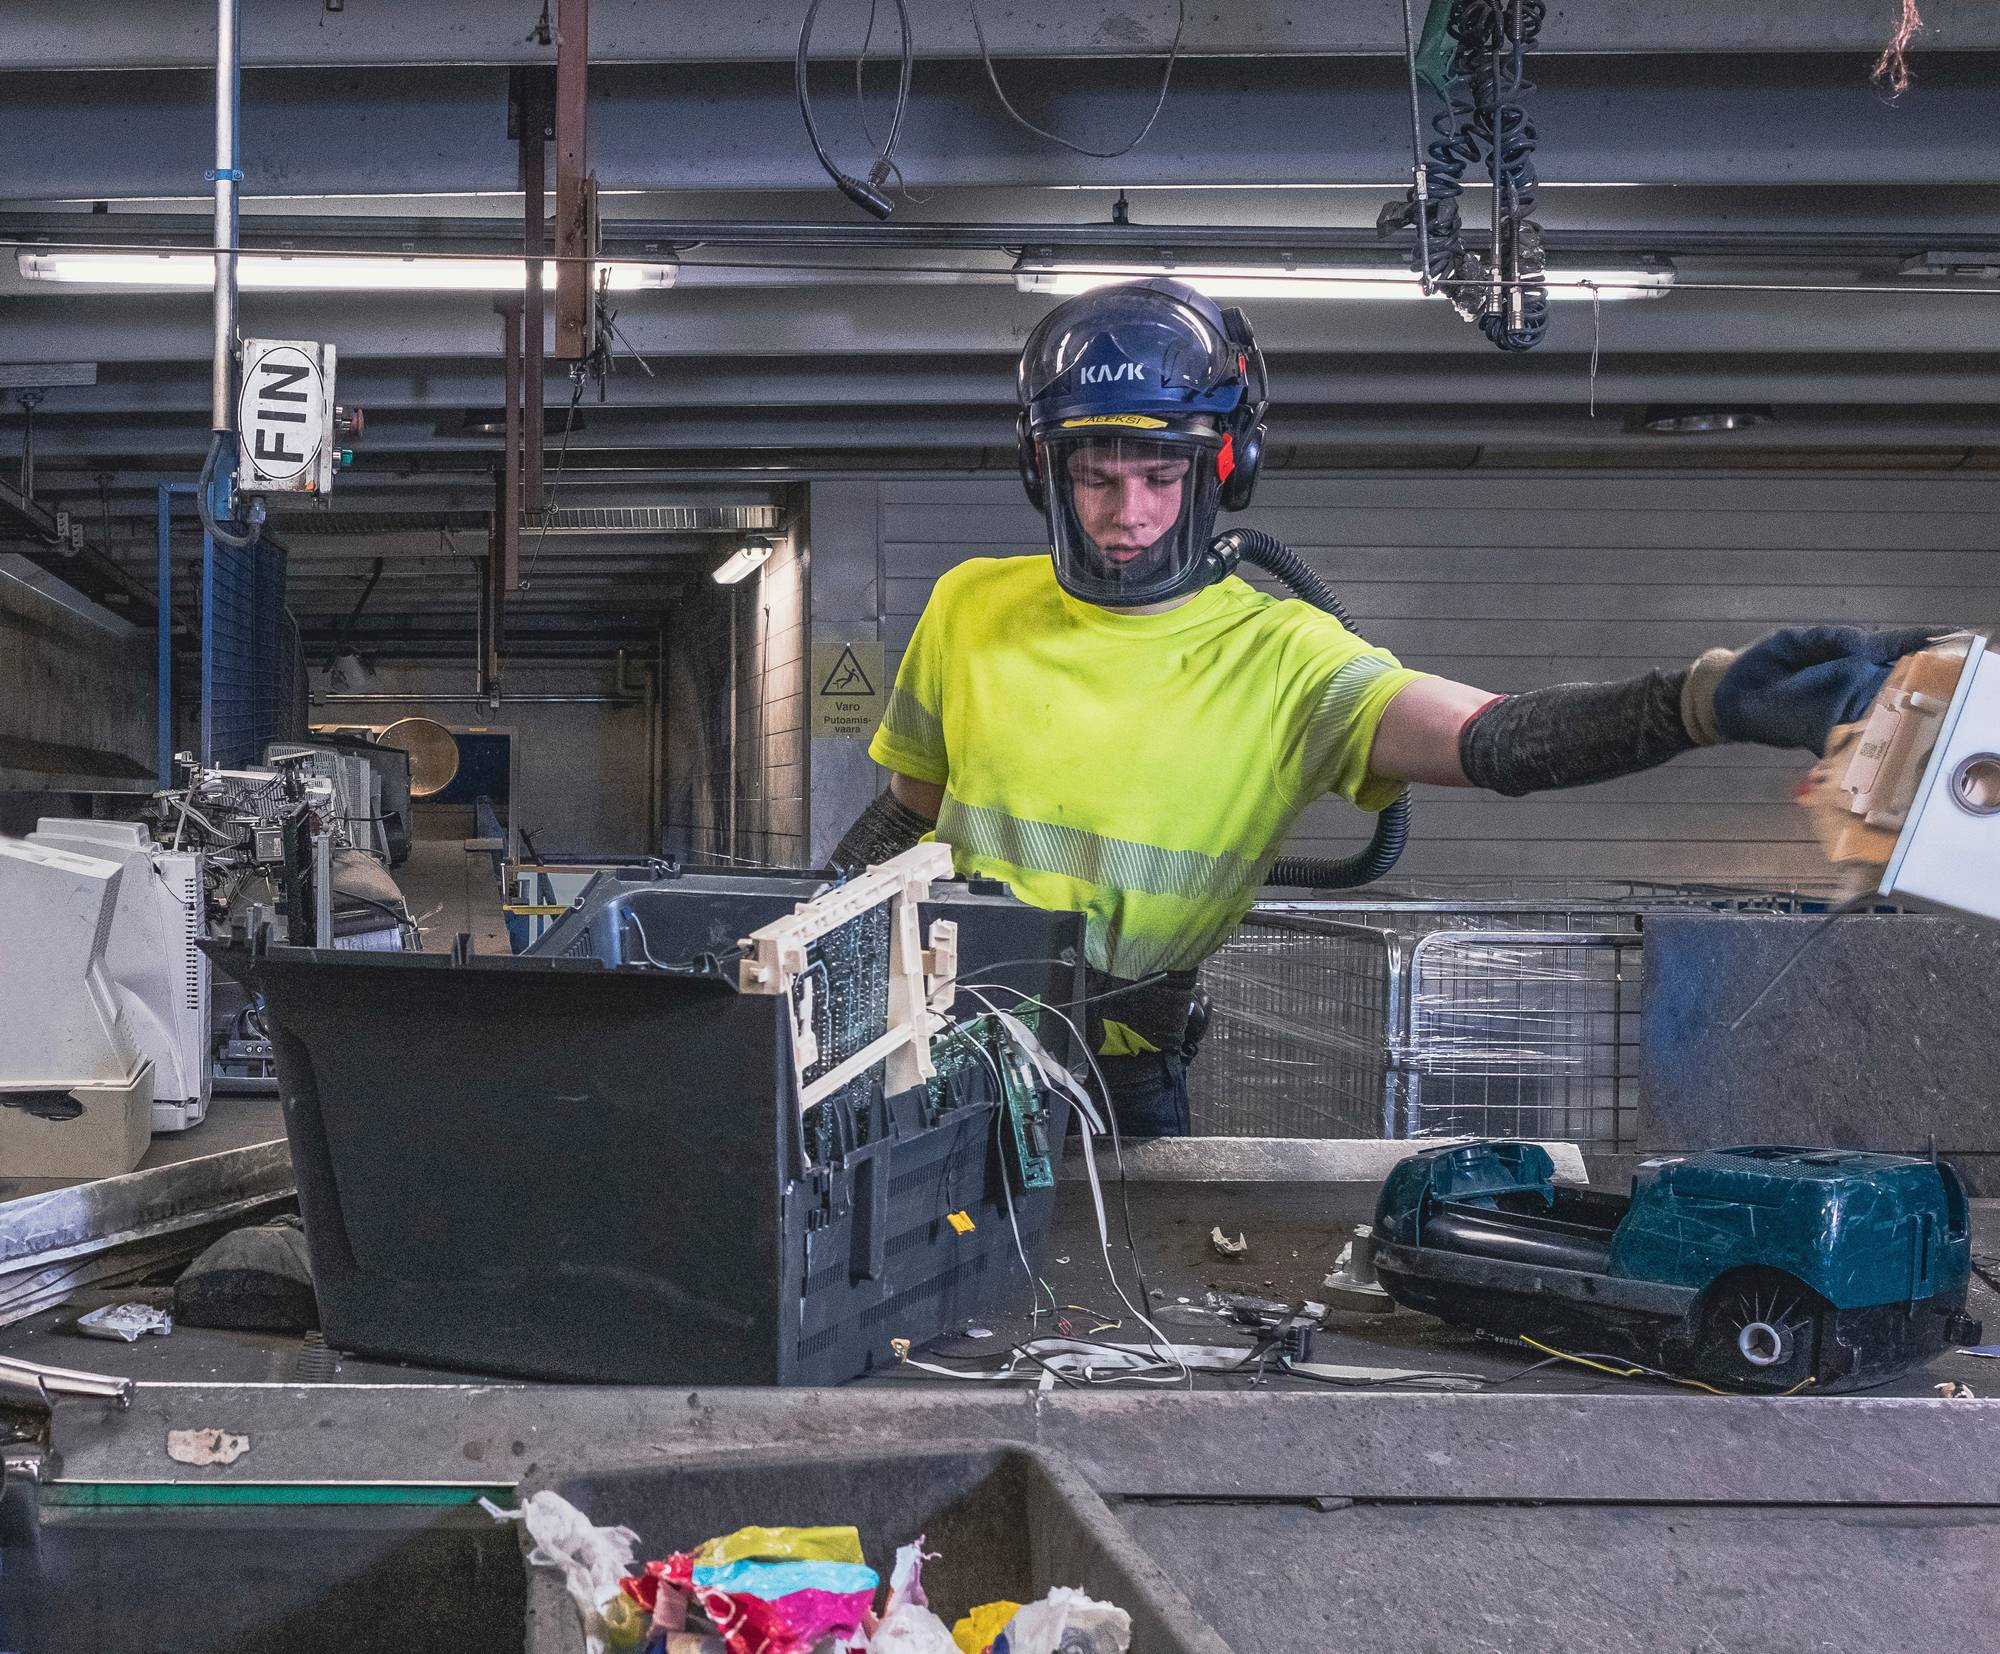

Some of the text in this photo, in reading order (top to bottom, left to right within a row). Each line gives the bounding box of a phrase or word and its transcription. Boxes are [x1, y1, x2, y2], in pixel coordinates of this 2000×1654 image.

[1080, 363, 1145, 385] KASK
[255, 363, 310, 463] FIN
[1085, 415, 1142, 425] ALEKSI
[835, 702, 860, 711] Varo
[824, 716, 872, 724] Putoamis-
